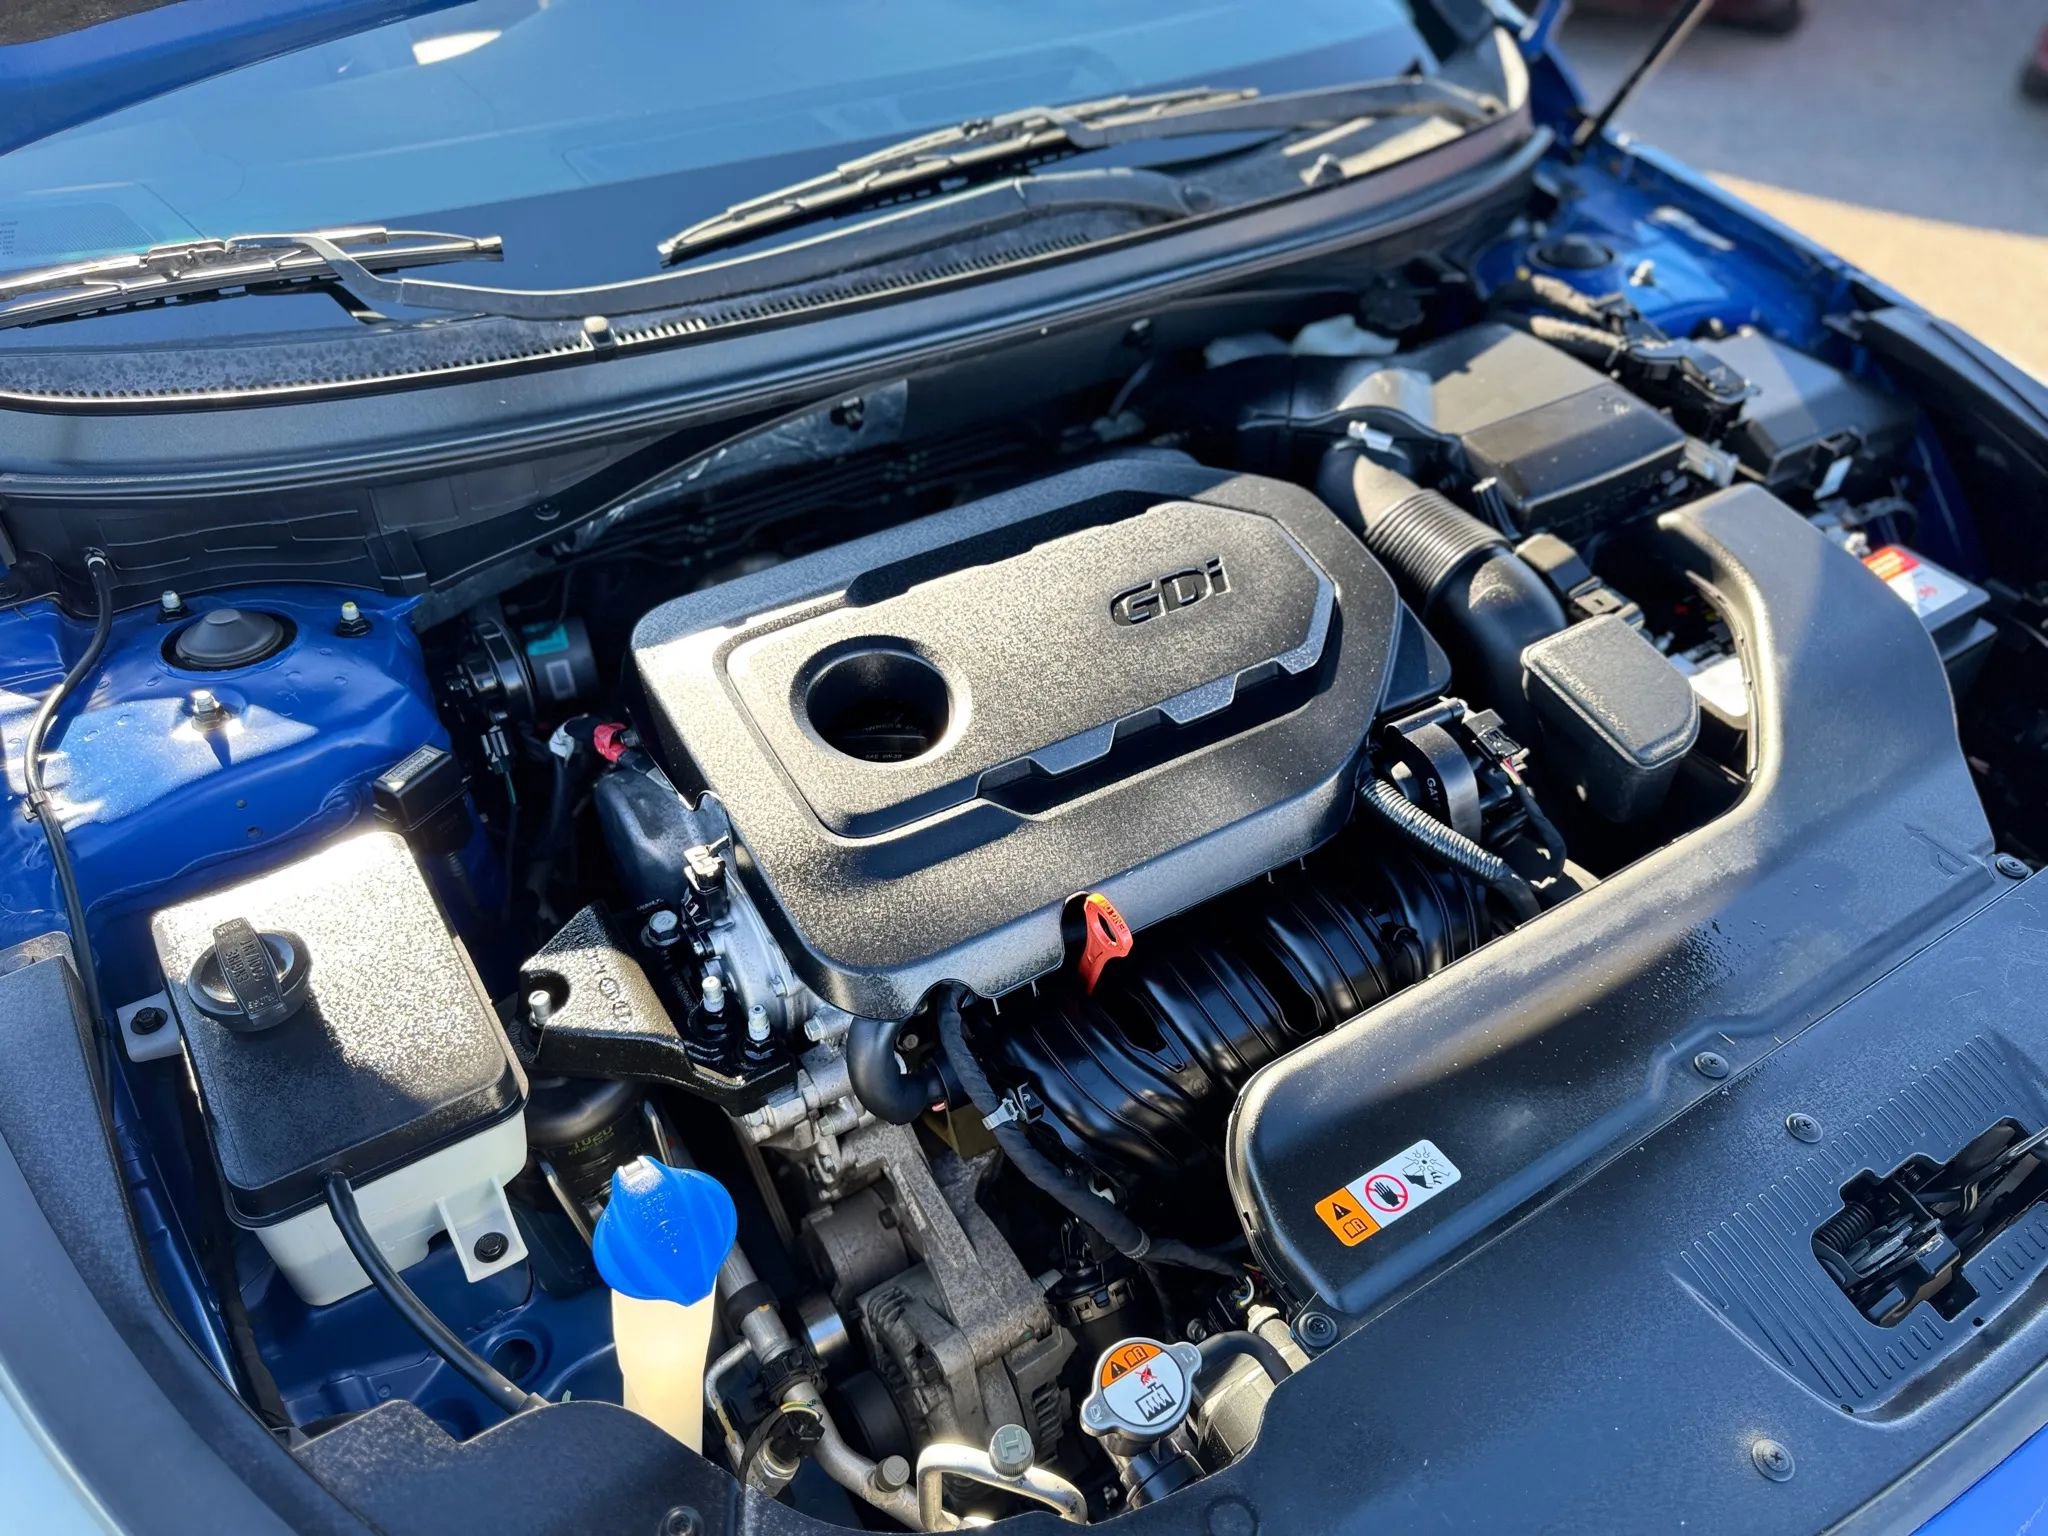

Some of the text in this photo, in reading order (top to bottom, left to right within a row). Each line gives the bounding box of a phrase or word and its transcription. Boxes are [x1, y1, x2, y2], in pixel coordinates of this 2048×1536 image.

[1110, 555, 1231, 627] GDi
[226, 949, 249, 983] ENGINE
[240, 939, 265, 982] COOLANT
[998, 1429, 1026, 1459] H
